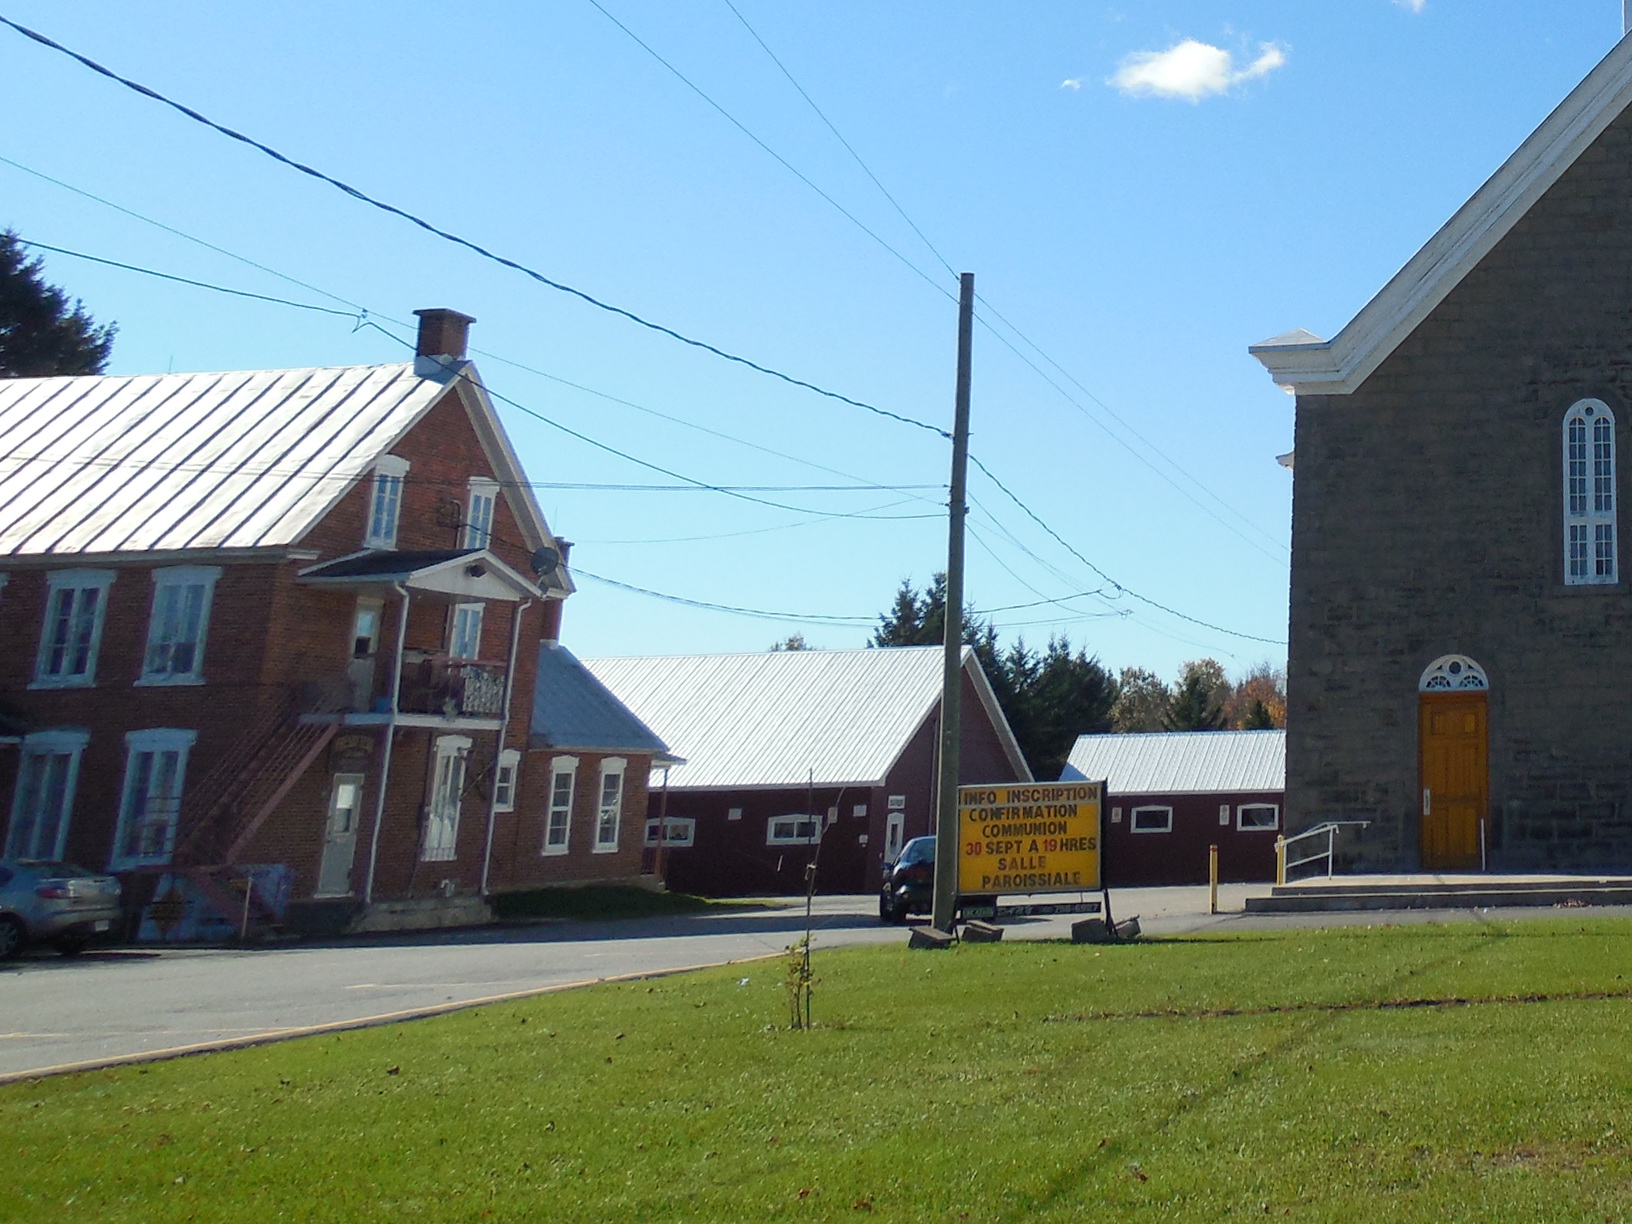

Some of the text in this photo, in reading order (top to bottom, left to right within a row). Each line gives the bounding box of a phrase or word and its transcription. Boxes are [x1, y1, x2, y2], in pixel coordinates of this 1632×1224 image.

[964, 787, 1098, 805] INFO INSCRIPTION
[969, 804, 1078, 822] CONFIRMATION
[982, 821, 1067, 838] COMMUNION
[966, 837, 1097, 856] 30 SEPT A 19 HRES
[998, 855, 1046, 871] SALLE
[982, 871, 1081, 889] PAROISSIALE
